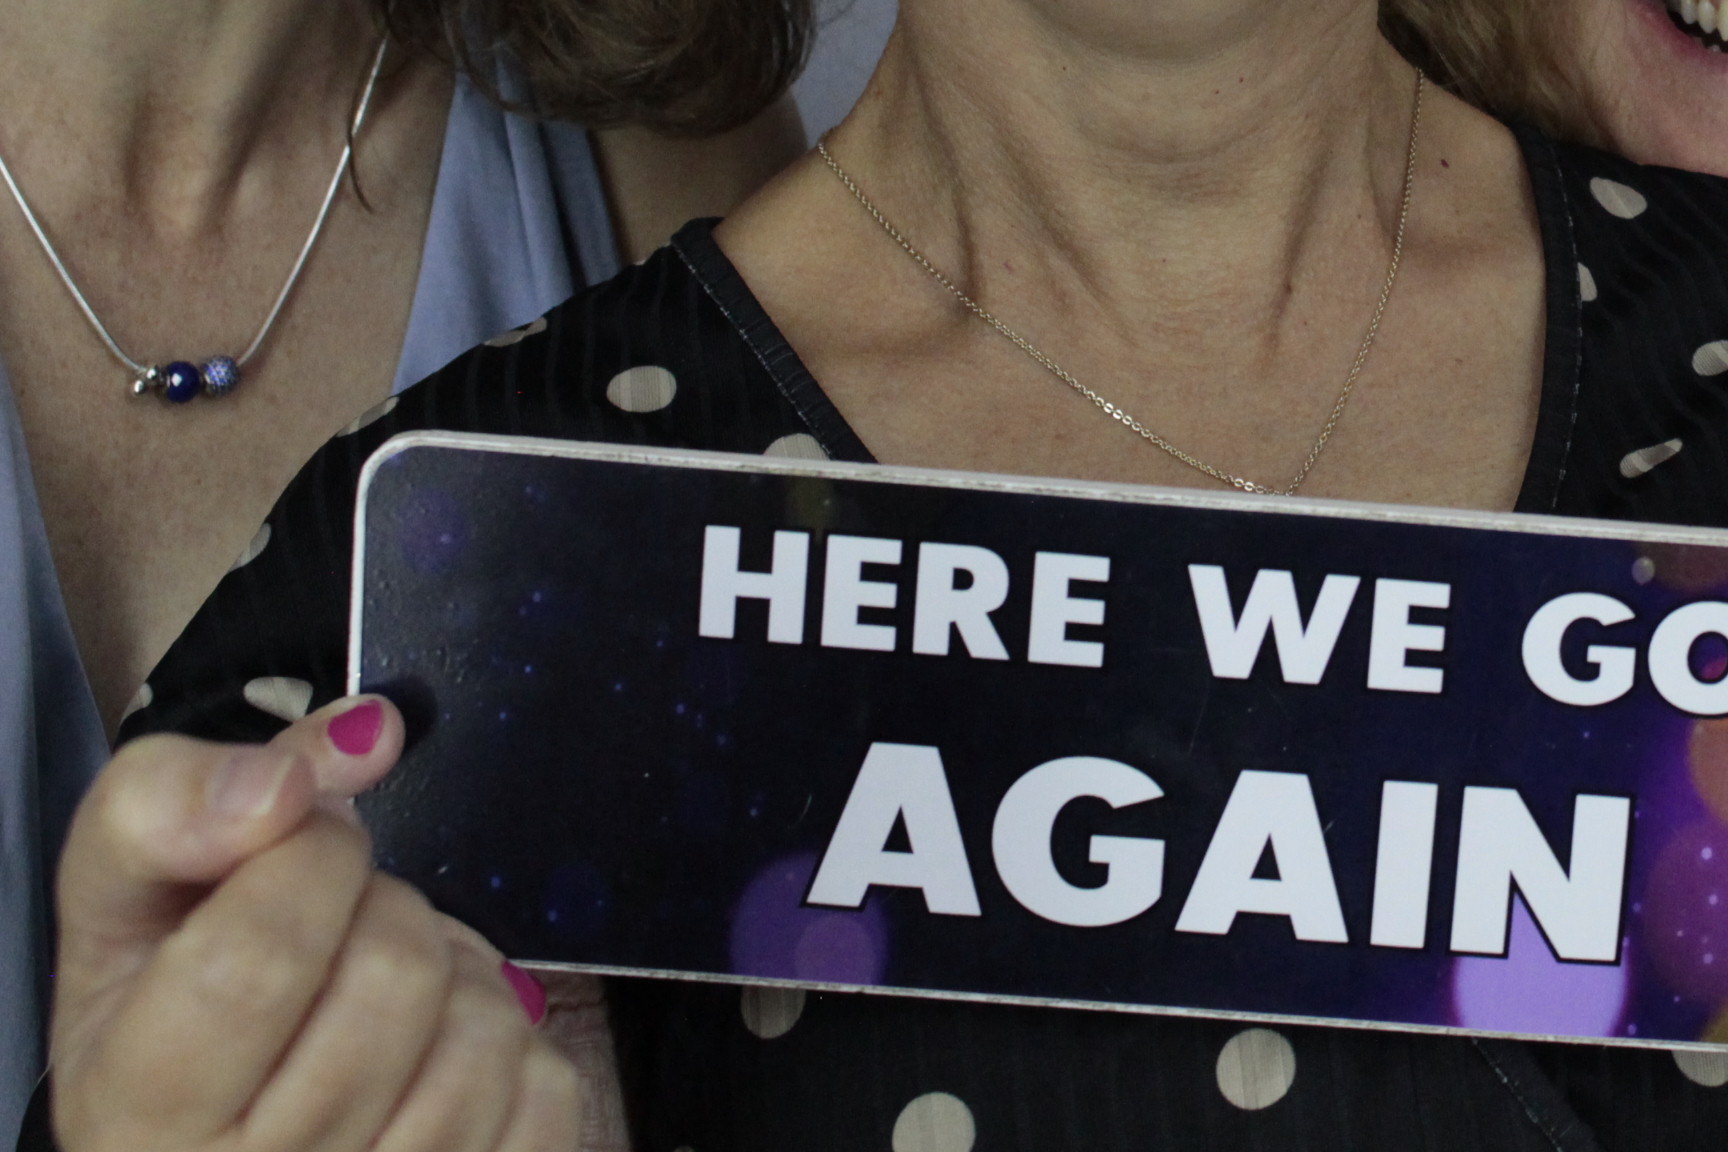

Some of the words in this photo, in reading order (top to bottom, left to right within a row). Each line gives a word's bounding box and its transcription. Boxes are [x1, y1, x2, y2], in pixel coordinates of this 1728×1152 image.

[699, 526, 1109, 667] HERE
[1189, 565, 1450, 693] WE
[808, 744, 1630, 961] AGAIN
